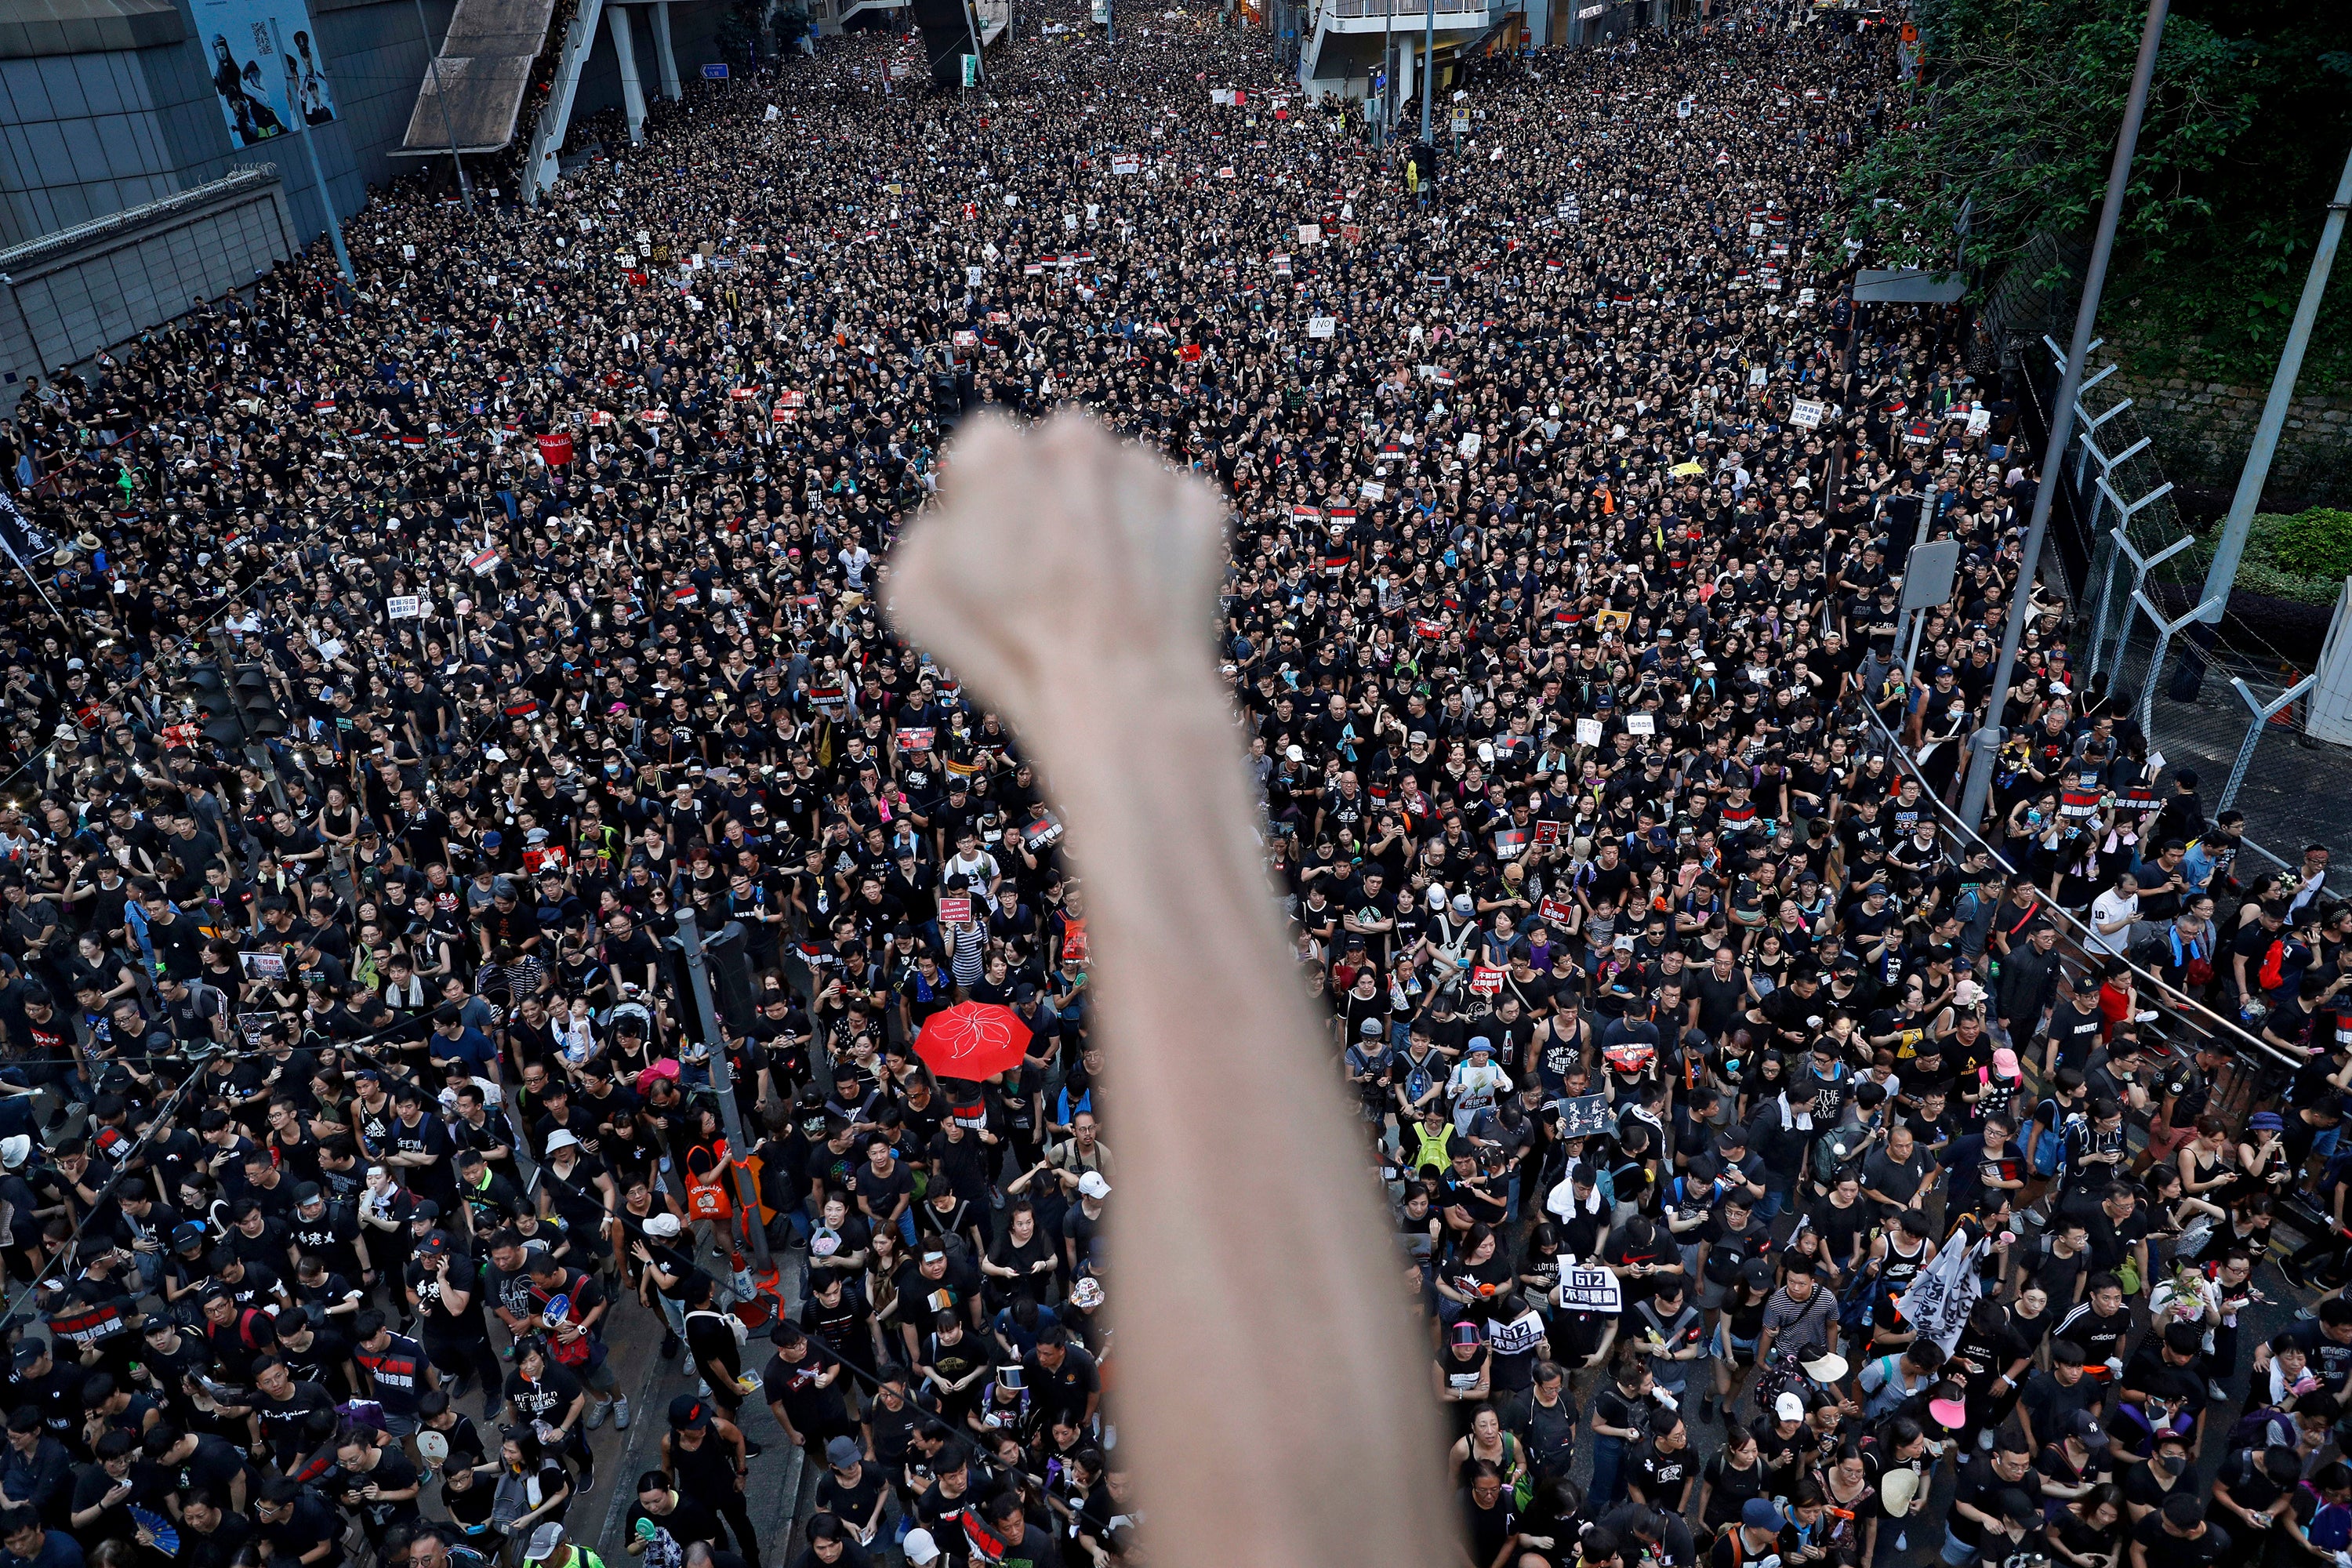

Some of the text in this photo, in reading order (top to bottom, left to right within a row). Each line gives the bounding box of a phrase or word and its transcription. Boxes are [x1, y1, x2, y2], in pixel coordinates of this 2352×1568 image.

[1316, 320, 1330, 328] NO
[2114, 799, 2161, 808] 沒有暴動
[1895, 811, 1918, 821] AAPE
[1497, 843, 1526, 855] 沒有
[1544, 908, 1566, 920] 反送中
[2095, 910, 2105, 920] 10
[1547, 1062, 1566, 1072] ATHLE
[1818, 1088, 1839, 1098] THE
[1816, 1096, 1840, 1105] AME
[1813, 1110, 1836, 1119] AME
[325, 1171, 358, 1185] BASKETBALL
[1892, 1263, 1915, 1272] NIKE
[1575, 1272, 1604, 1287] 612
[499, 1290, 528, 1301] BLAC
[1564, 1288, 1615, 1303] 不是暴動
[507, 1299, 528, 1310] SILV
[1502, 1324, 1530, 1339] 612
[1492, 1333, 1541, 1350] 不是暴動
[517, 1398, 556, 1411] WRRIORS
[2089, 1421, 2099, 1433] NY
